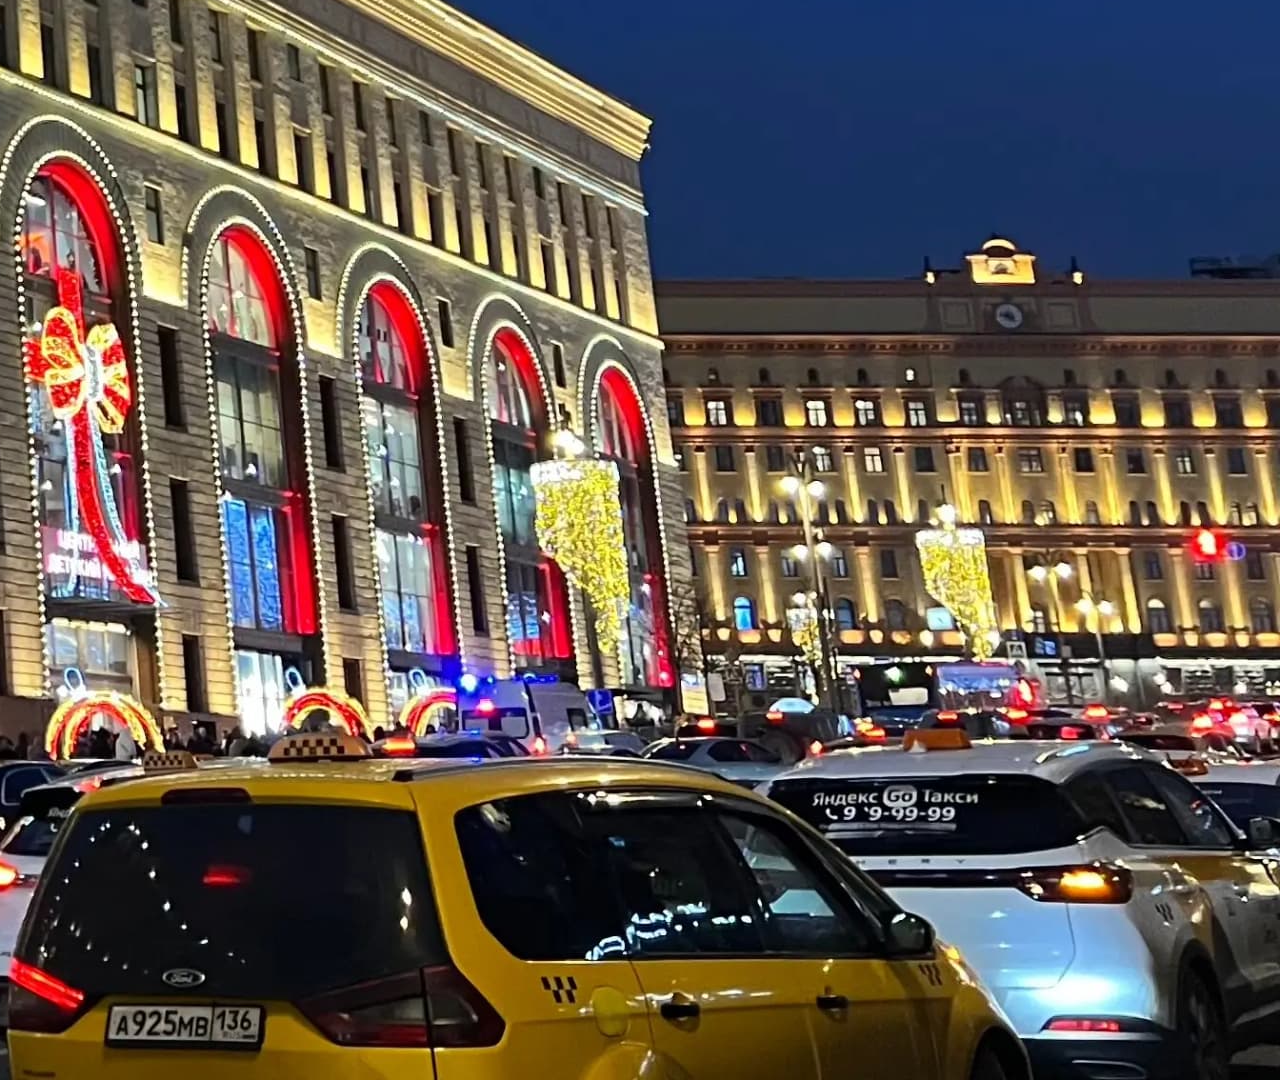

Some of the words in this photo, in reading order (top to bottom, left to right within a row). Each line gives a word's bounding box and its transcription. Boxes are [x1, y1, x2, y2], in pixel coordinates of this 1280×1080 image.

[812, 792, 879, 807] Яндекс
[843, 806, 956, 821] 99-99-99
[115, 1010, 209, 1037] А925МВ
[216, 1010, 252, 1032] 136
